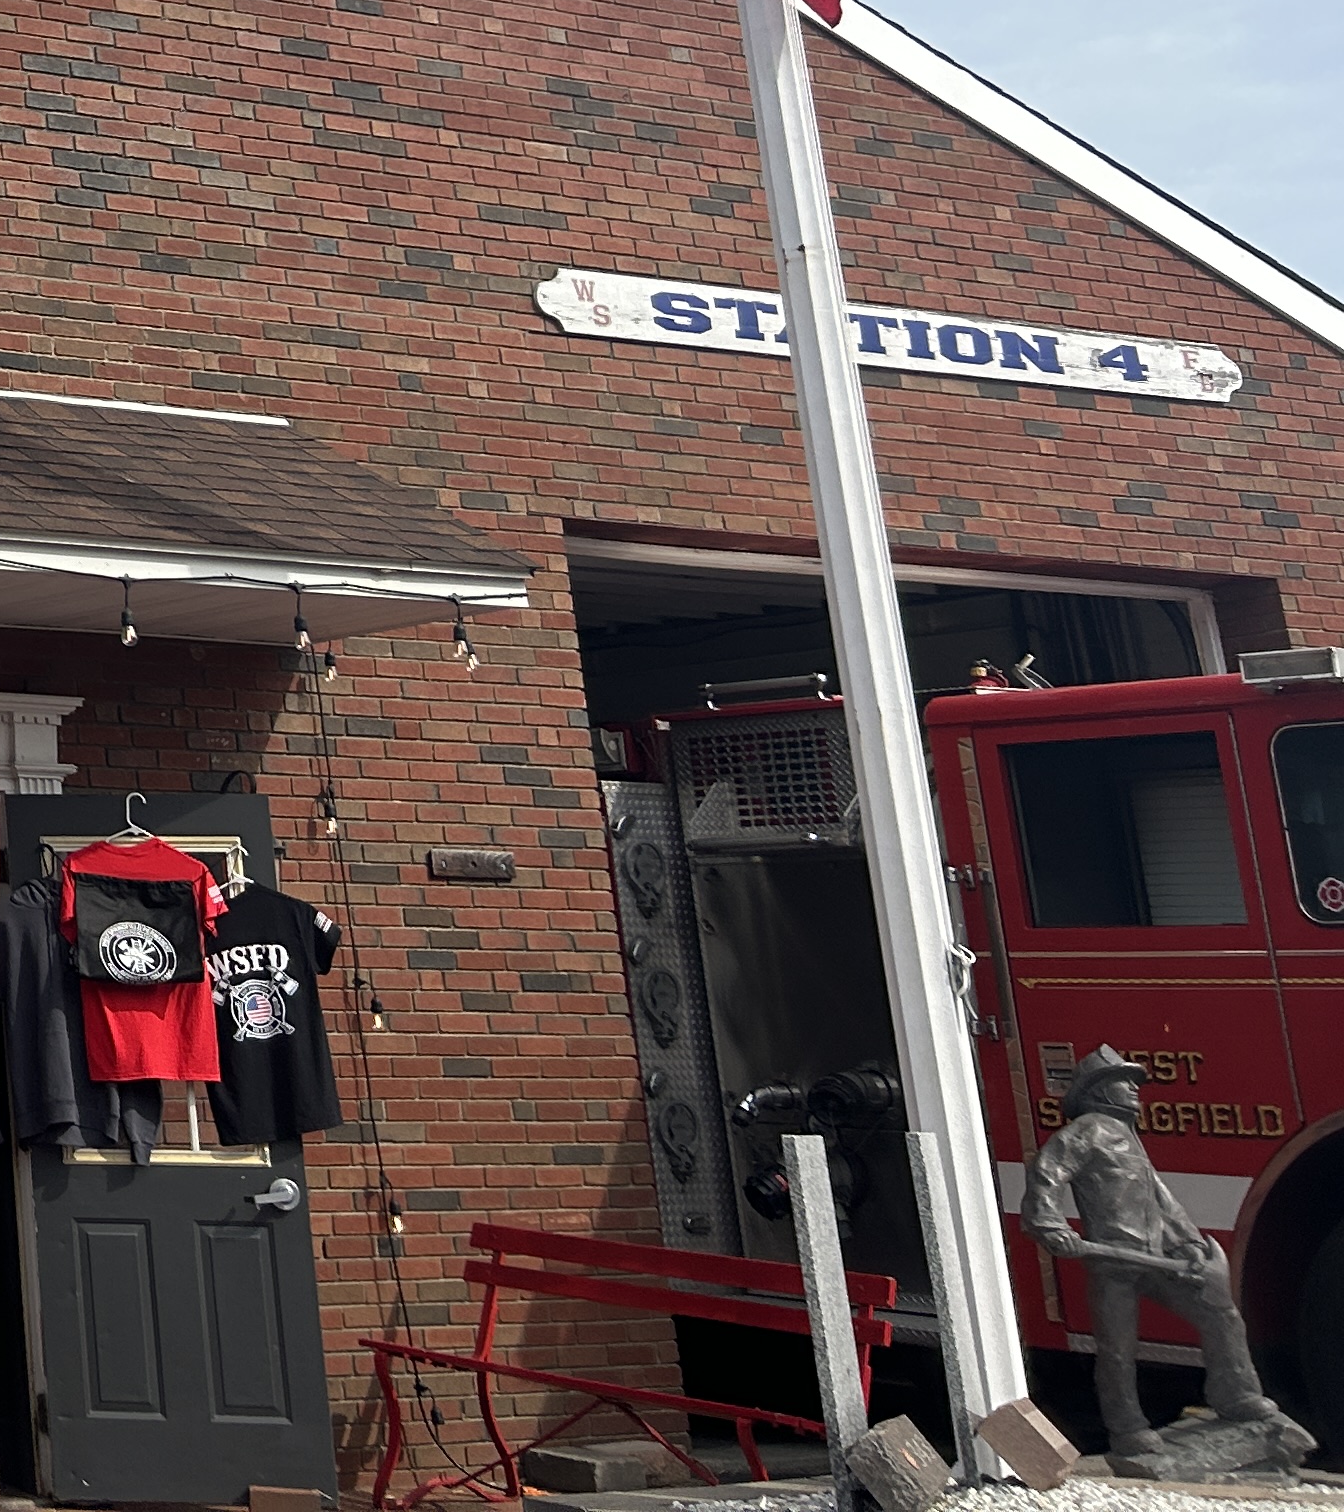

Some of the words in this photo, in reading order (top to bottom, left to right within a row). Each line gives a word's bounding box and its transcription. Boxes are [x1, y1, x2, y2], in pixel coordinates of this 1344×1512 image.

[650, 290, 1065, 376] STTION
[1098, 344, 1149, 382] 4
[204, 944, 290, 983] WSFD
[1118, 1049, 1204, 1084] EST
